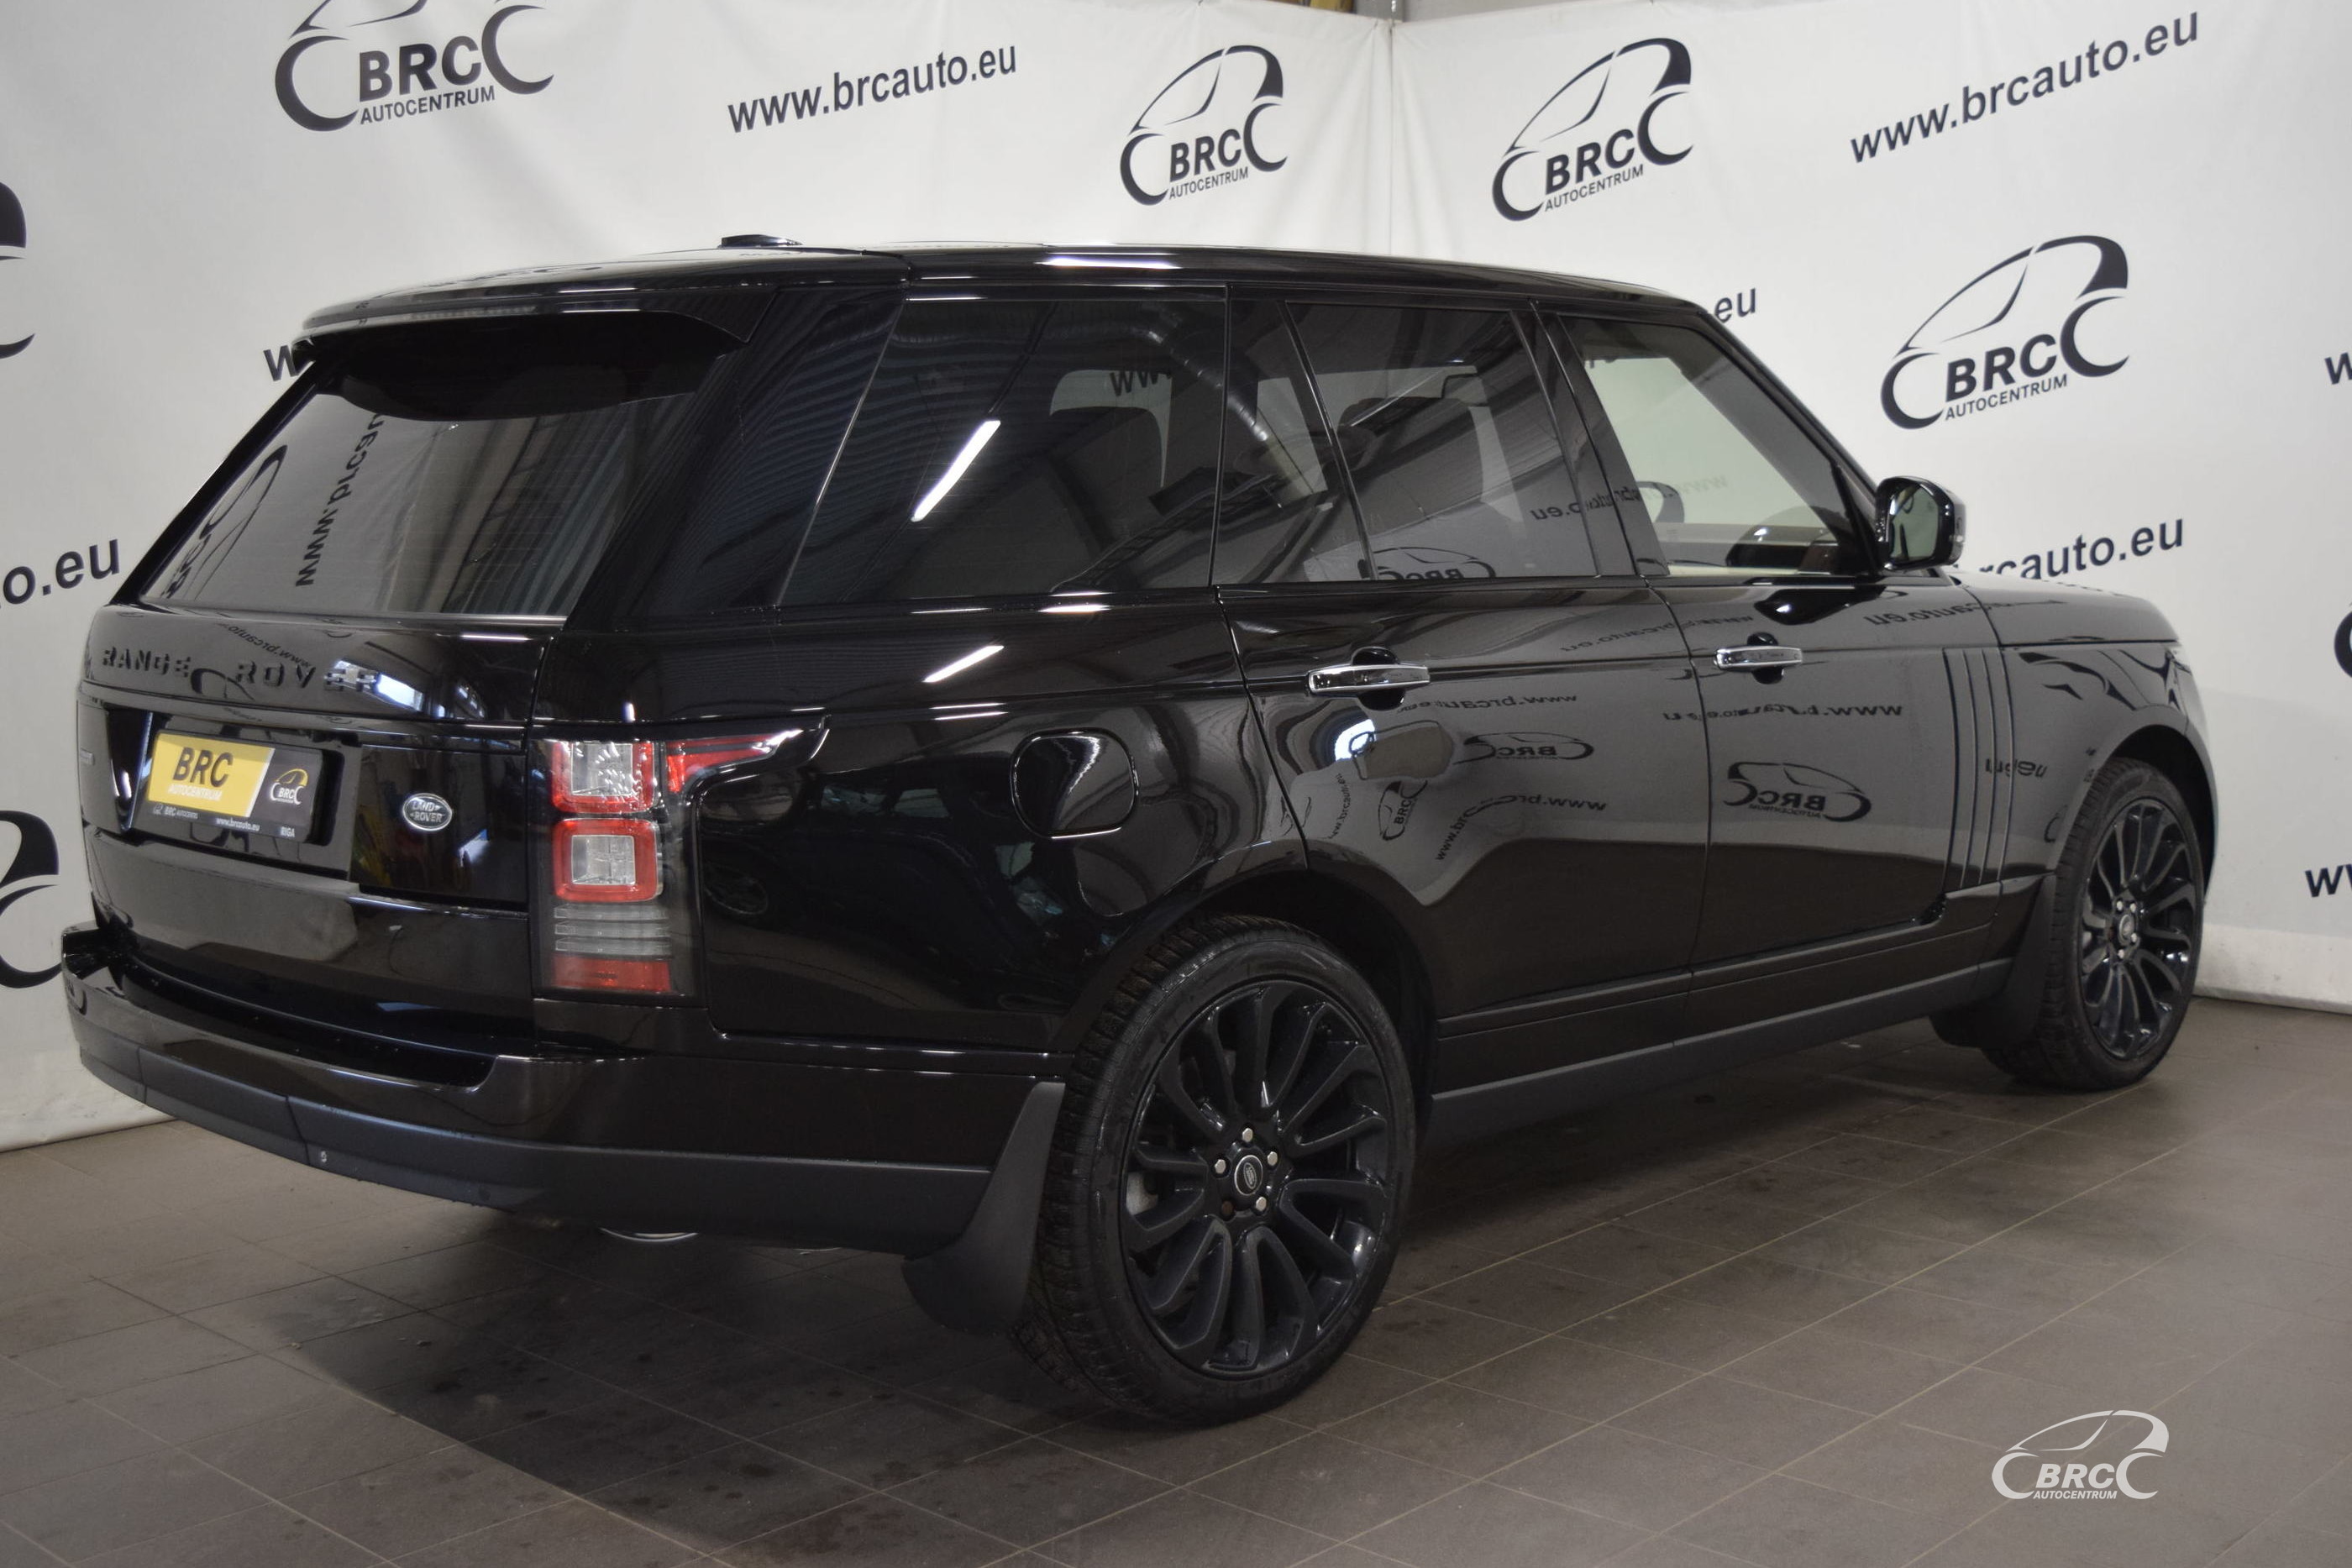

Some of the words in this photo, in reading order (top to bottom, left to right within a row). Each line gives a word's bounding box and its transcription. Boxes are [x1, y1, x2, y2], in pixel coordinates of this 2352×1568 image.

[360, 36, 481, 102] BRC
[727, 45, 1016, 134] www.brcauto.eu
[1851, 12, 2197, 163] www.brcauto.eu
[360, 86, 495, 125] AUTOCENTRUM
[1169, 129, 1241, 182] BRC
[1545, 128, 1635, 195] BRC
[1168, 166, 1248, 200] AUTOCENTRUM
[1546, 164, 1644, 212] AUTOCENTRUM
[1945, 333, 2057, 402] BRC
[1945, 374, 2067, 420] AUTOCENTRUM
[102, 646, 192, 679] RANGE
[237, 660, 379, 694] ROVER
[172, 747, 234, 788] BRC
[168, 783, 223, 801] AUTOCENTRUM
[413, 810, 443, 822] ROVER
